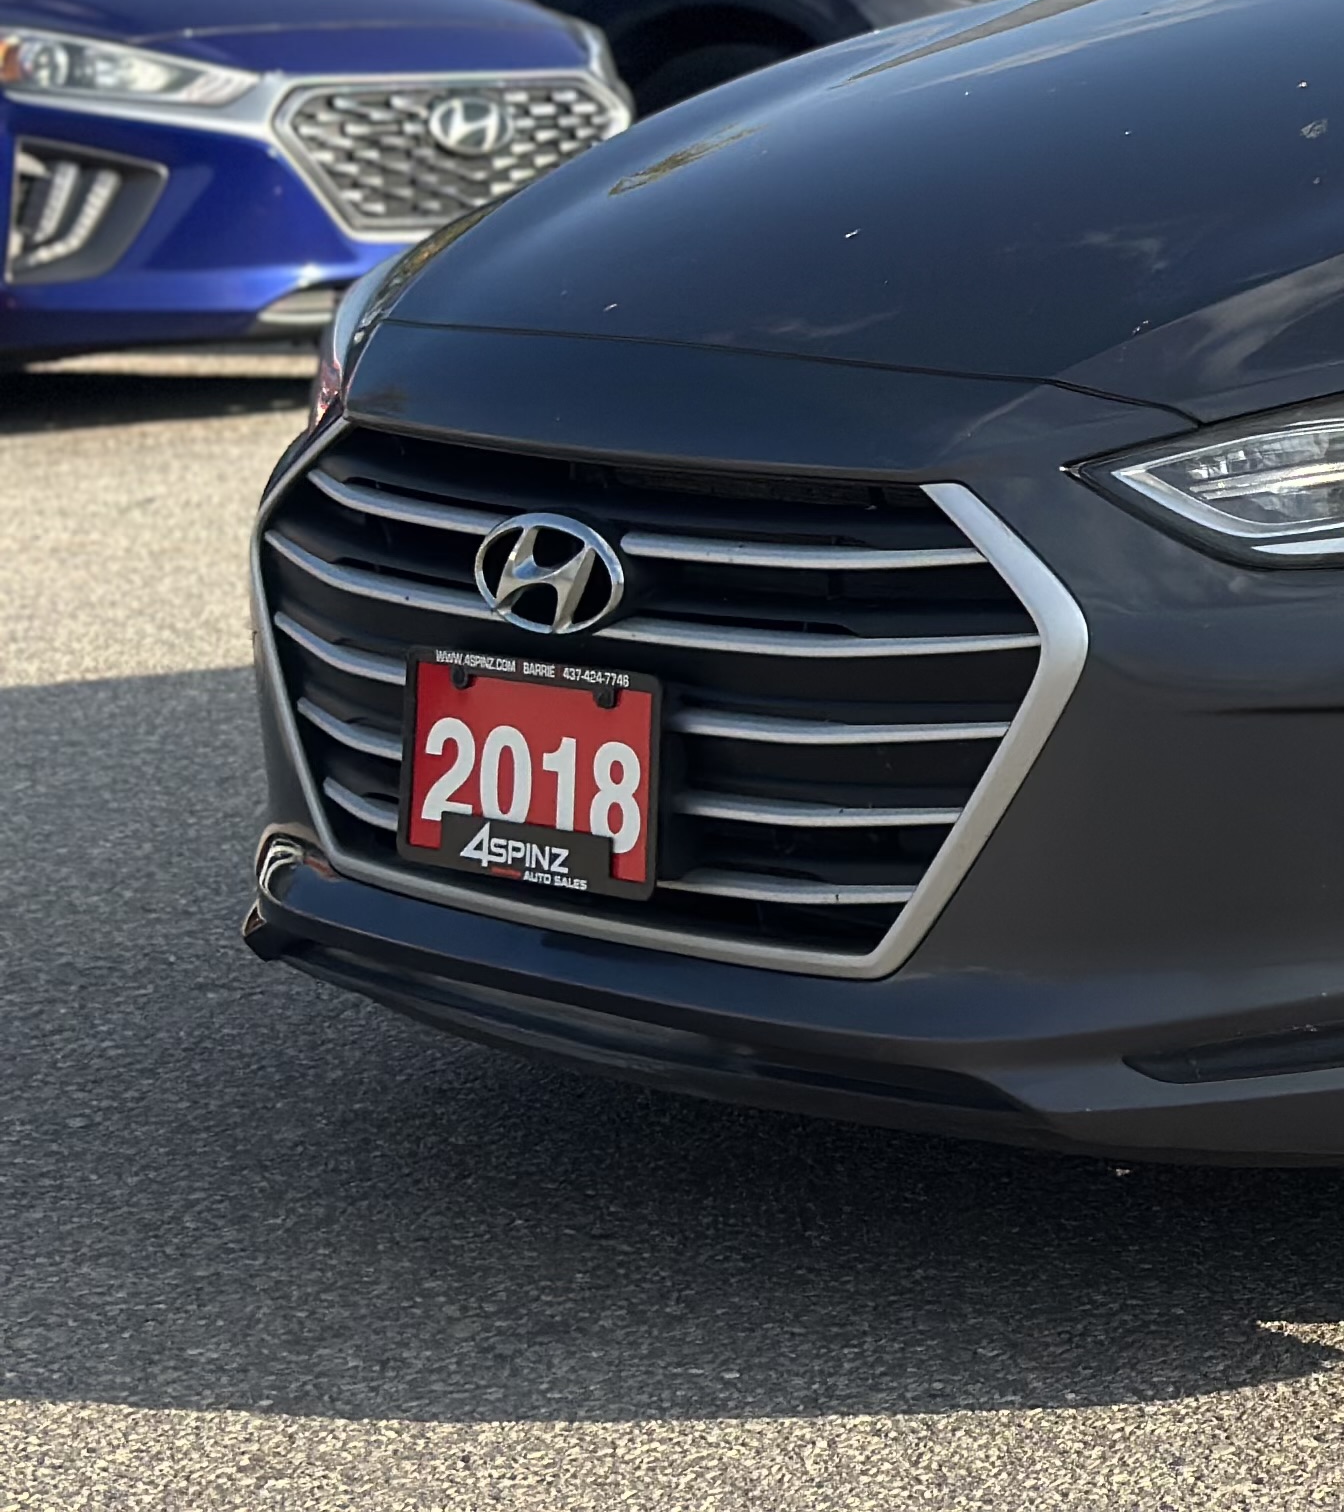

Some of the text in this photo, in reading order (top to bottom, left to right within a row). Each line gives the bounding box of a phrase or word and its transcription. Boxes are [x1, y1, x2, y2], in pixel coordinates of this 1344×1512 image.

[523, 661, 556, 678] BARRIE
[421, 716, 642, 854] 2018
[459, 821, 569, 874] 4SPINZ
[522, 870, 588, 891] AUTO SALES
